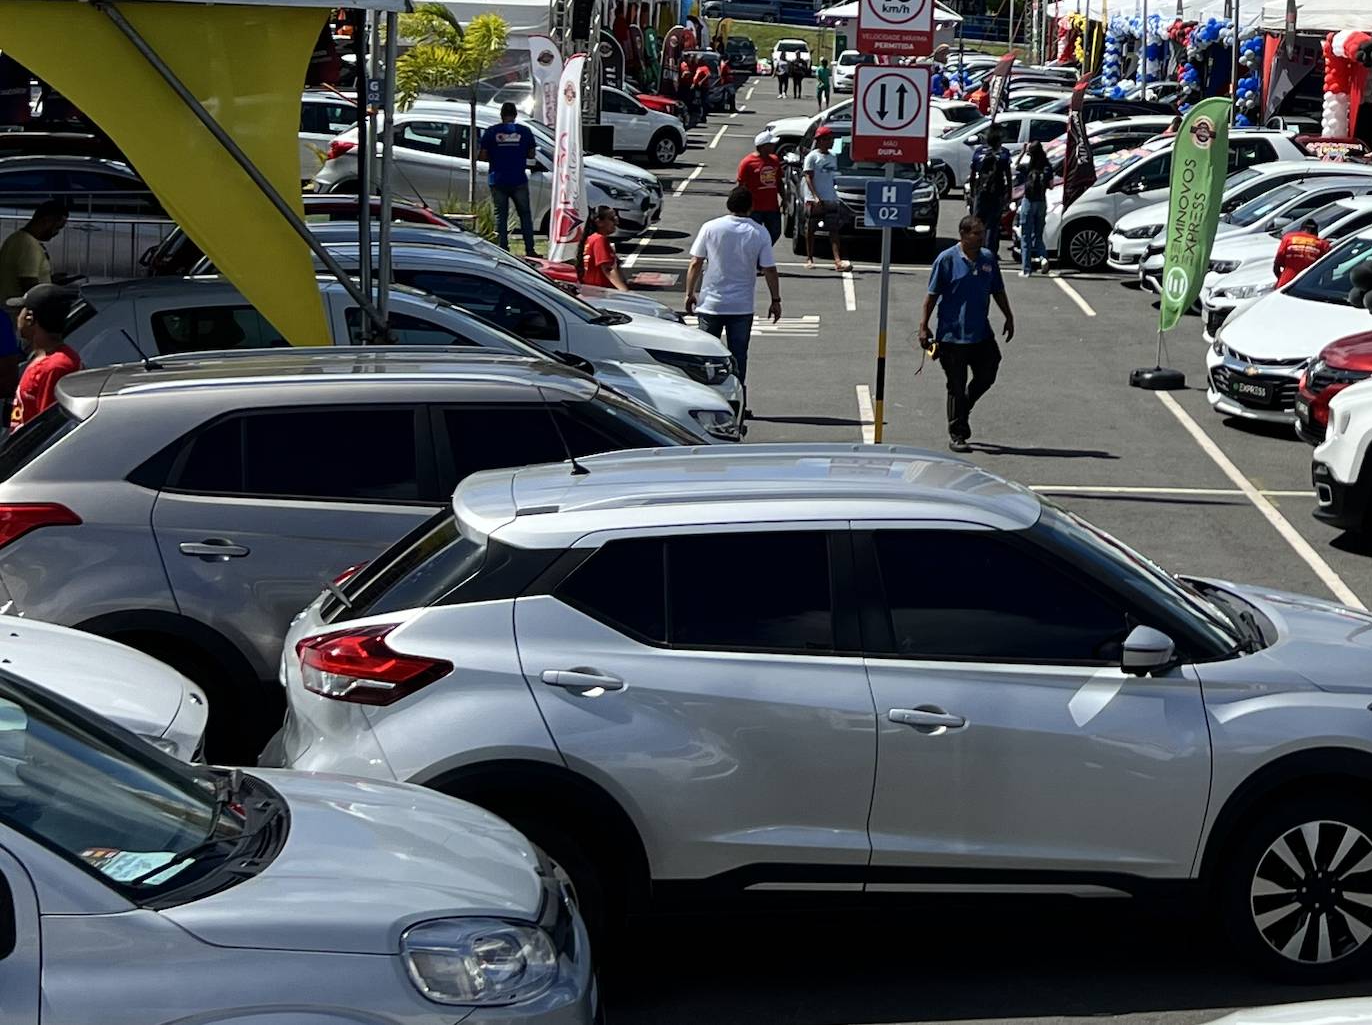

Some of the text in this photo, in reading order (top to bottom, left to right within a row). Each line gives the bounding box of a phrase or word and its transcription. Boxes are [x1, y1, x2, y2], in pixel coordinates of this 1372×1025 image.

[882, 4, 910, 14] km/h
[874, 41, 914, 50] PERMITIDA
[370, 81, 379, 91] G
[882, 186, 896, 203] H
[879, 207, 898, 220] 02
[1170, 158, 1197, 263] SEMINOVOS
[1182, 192, 1206, 267] EXPRESS
